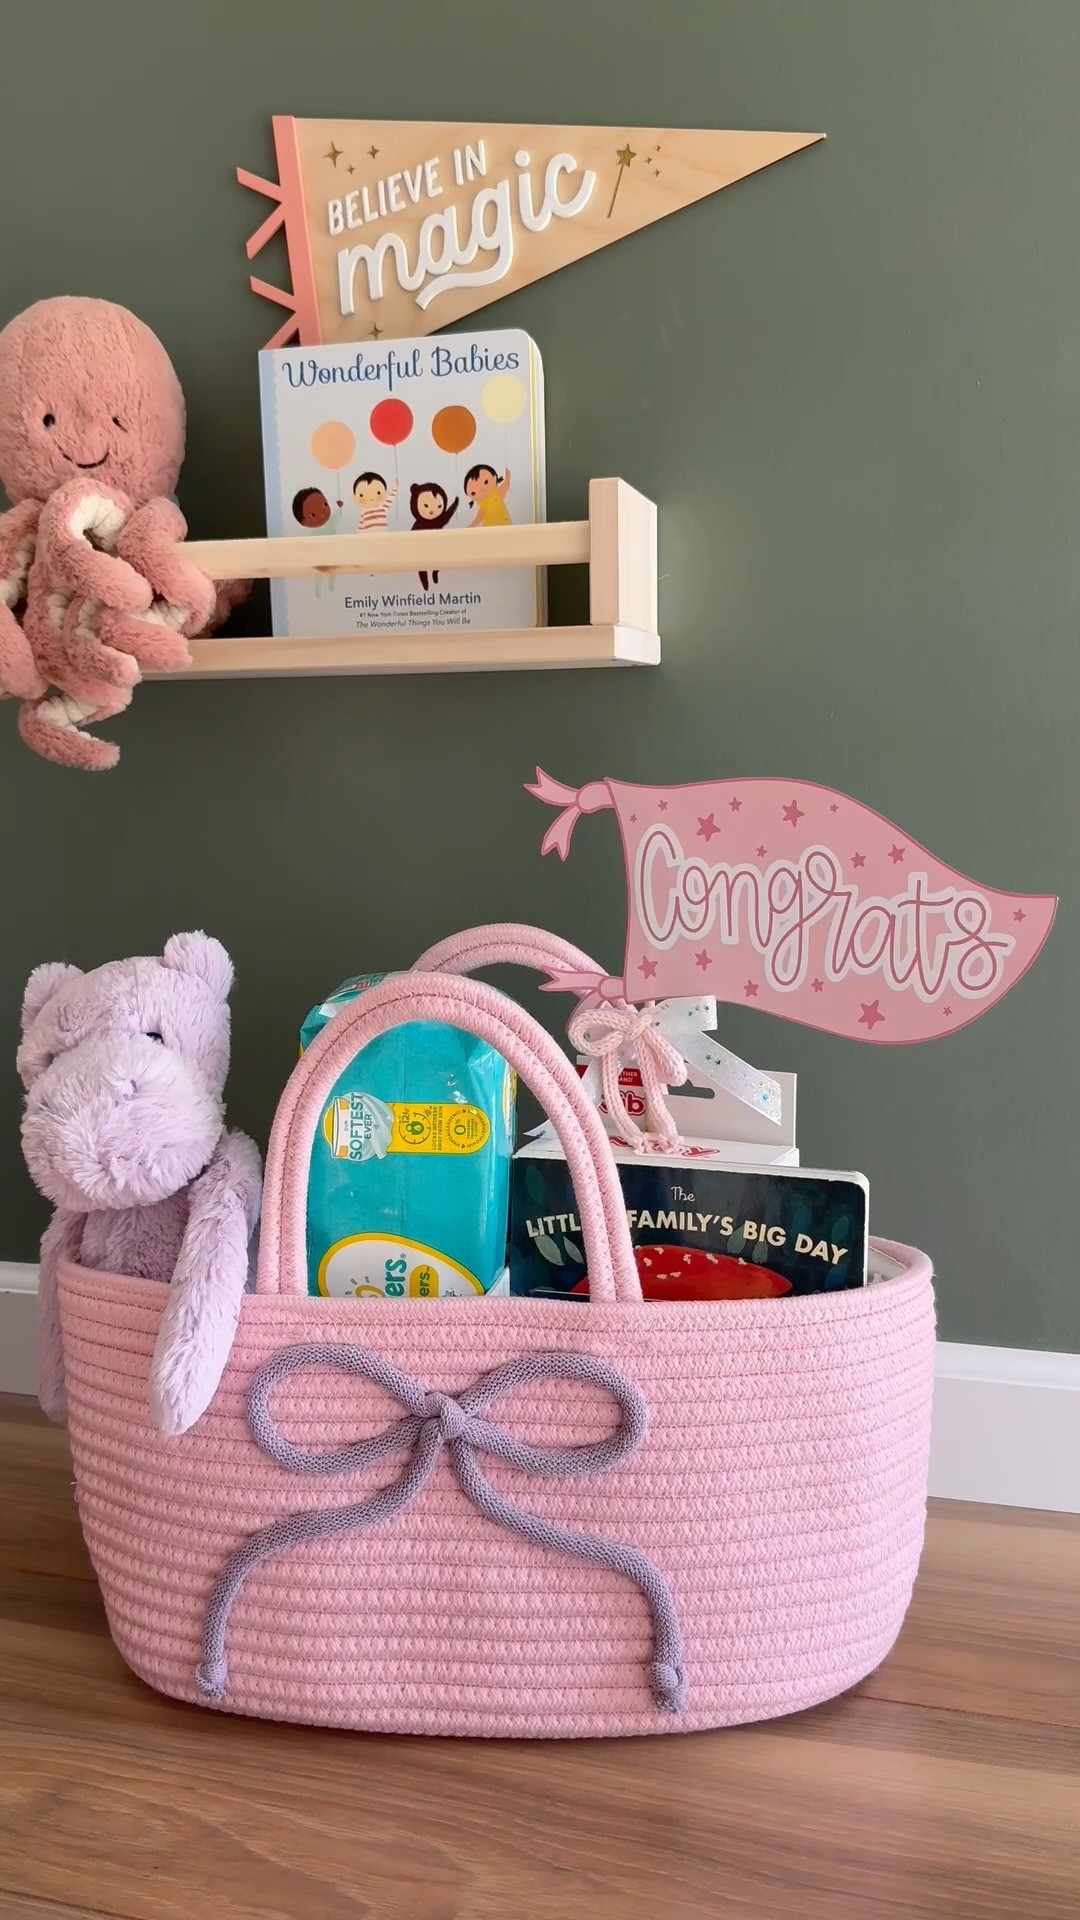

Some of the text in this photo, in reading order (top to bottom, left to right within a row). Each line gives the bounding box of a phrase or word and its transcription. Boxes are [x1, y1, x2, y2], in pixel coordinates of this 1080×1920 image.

[327, 139, 487, 236] BELIEVE IN
[337, 150, 597, 316] magic
[282, 343, 519, 391] Wonderful Babies
[344, 591, 481, 611] Emily Winfield Martin
[356, 617, 471, 629] The Wonderful Things You Will Be
[439, 608, 460, 616] Creator
[636, 825, 1014, 1001] Congrats
[349, 1092, 363, 1160] SOFTEST
[364, 1113, 372, 1140] EVER
[670, 1185, 696, 1202] The
[525, 1209, 849, 1265] LITTL FAMILY'S BIG DAY
